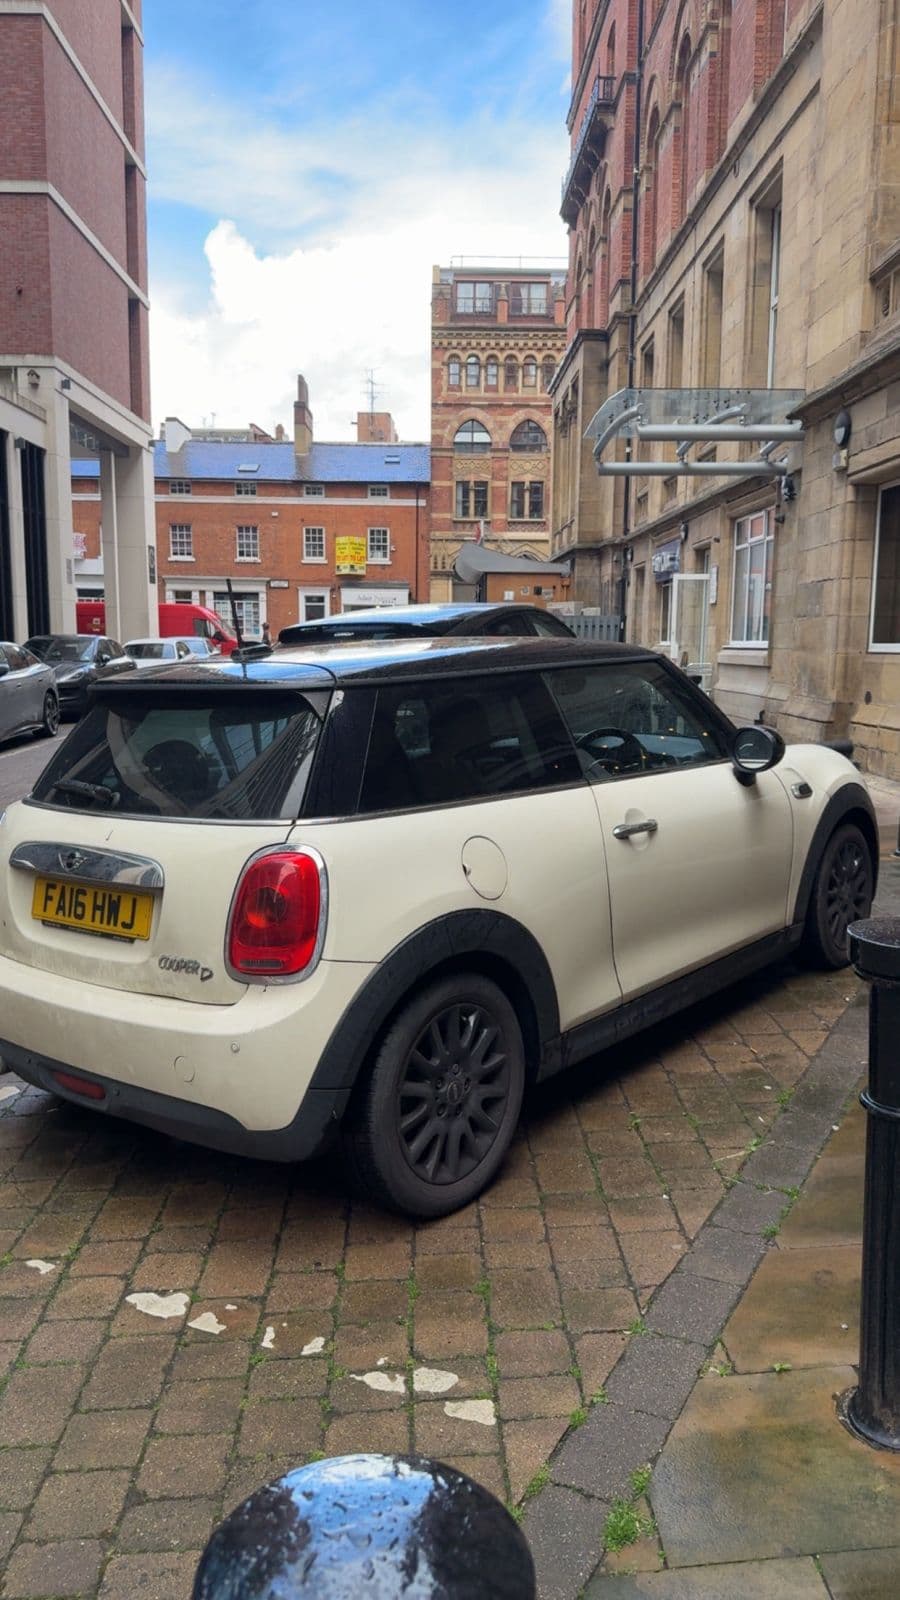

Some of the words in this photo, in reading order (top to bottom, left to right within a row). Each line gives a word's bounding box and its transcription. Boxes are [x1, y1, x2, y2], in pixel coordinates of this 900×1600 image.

[43, 882, 88, 920] FA16
[91, 890, 137, 929] HWJ
[158, 955, 200, 975] COOPER
[200, 967, 214, 982] D
